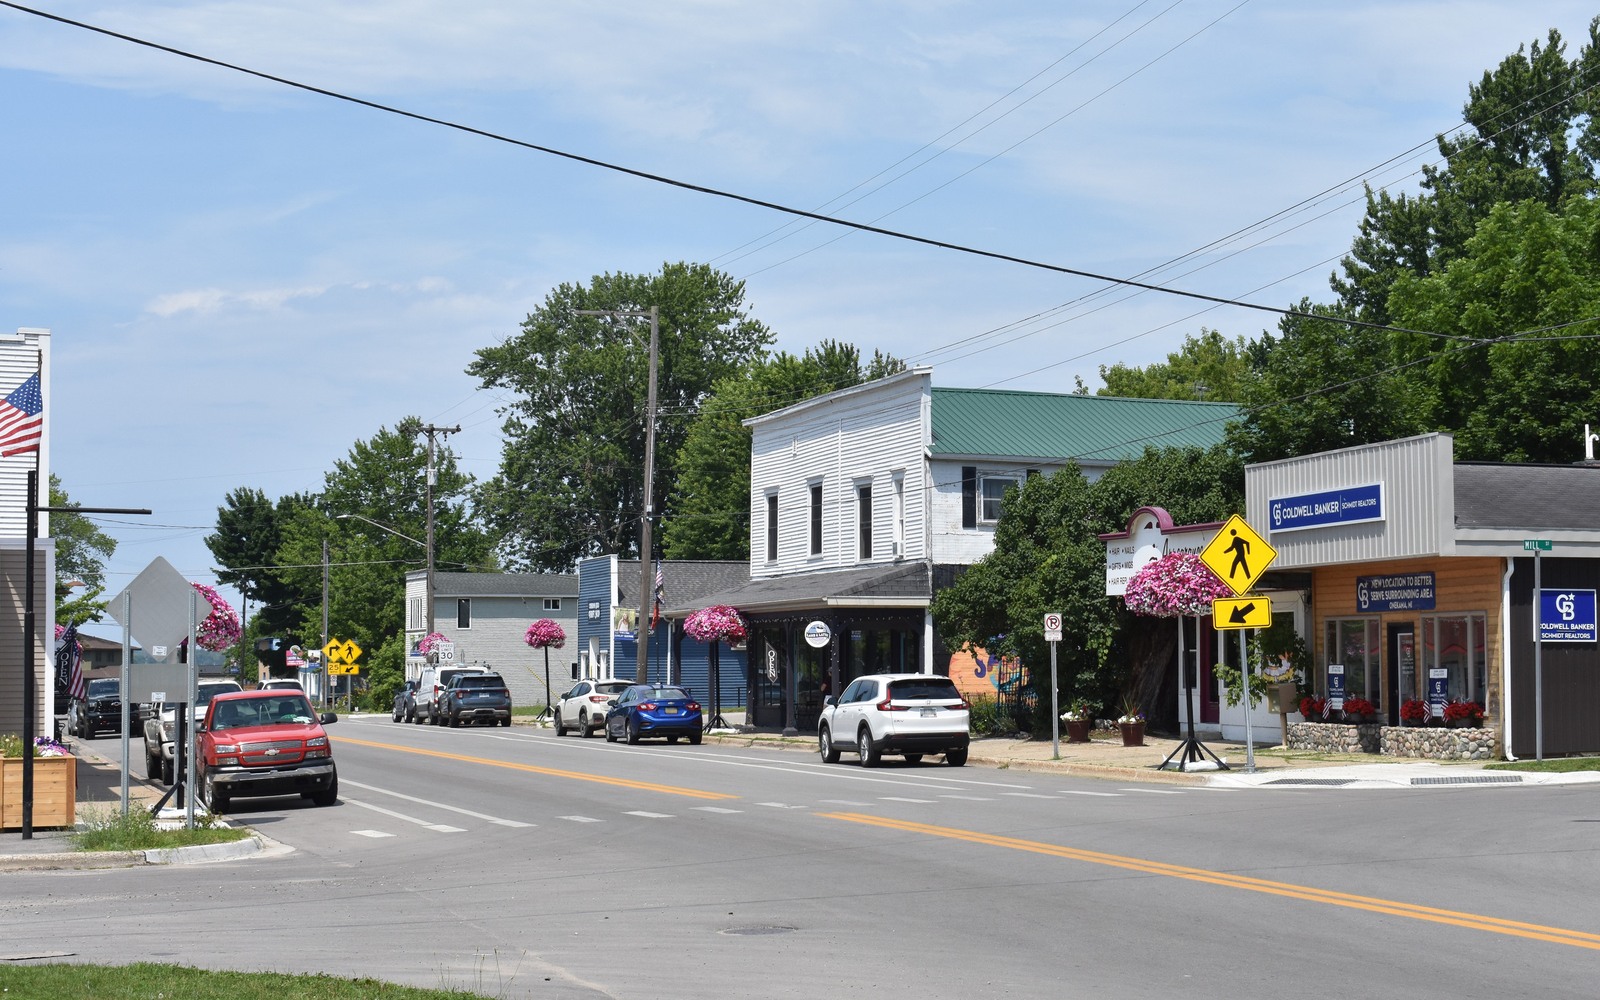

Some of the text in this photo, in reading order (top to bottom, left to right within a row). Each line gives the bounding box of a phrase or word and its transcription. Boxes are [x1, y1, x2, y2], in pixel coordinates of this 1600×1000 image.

[1282, 498, 1376, 519] COLDWELL BANKER SCHMIDT REALTORS
[1124, 546, 1135, 554] NAILS
[1524, 541, 1540, 550] MILL
[1111, 562, 1121, 571] GIFTS
[1371, 575, 1433, 589] NEW LOCATION TO BETTER
[1370, 588, 1433, 601] SERVE SURROUNDING AREA
[440, 652, 453, 660] 30
[59, 652, 70, 687] OPEN
[768, 650, 776, 677] OPEN
